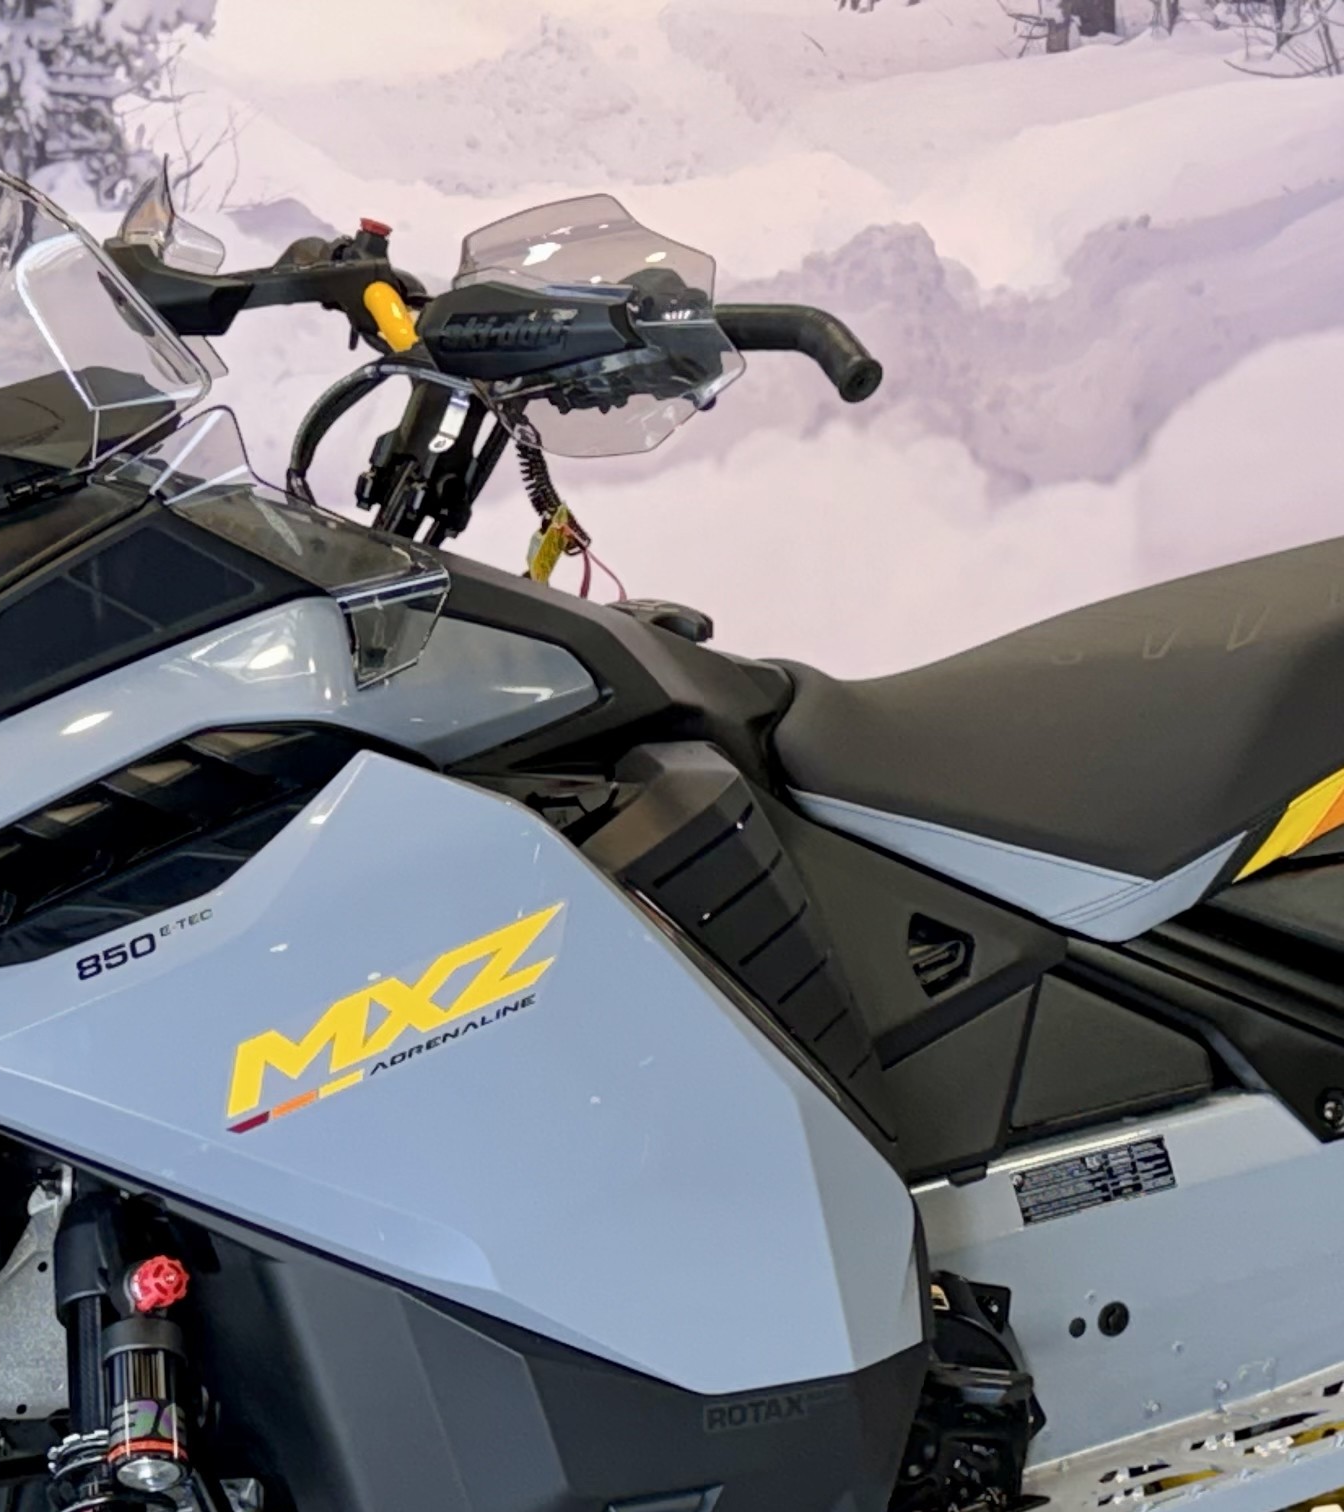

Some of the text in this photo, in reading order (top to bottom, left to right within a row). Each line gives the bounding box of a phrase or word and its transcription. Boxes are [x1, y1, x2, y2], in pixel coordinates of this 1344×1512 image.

[76, 908, 213, 981] 850 E-TEC
[227, 900, 567, 1119] MXZ
[369, 992, 537, 1077] ADRENALINE
[705, 1393, 805, 1431] ROTAX
